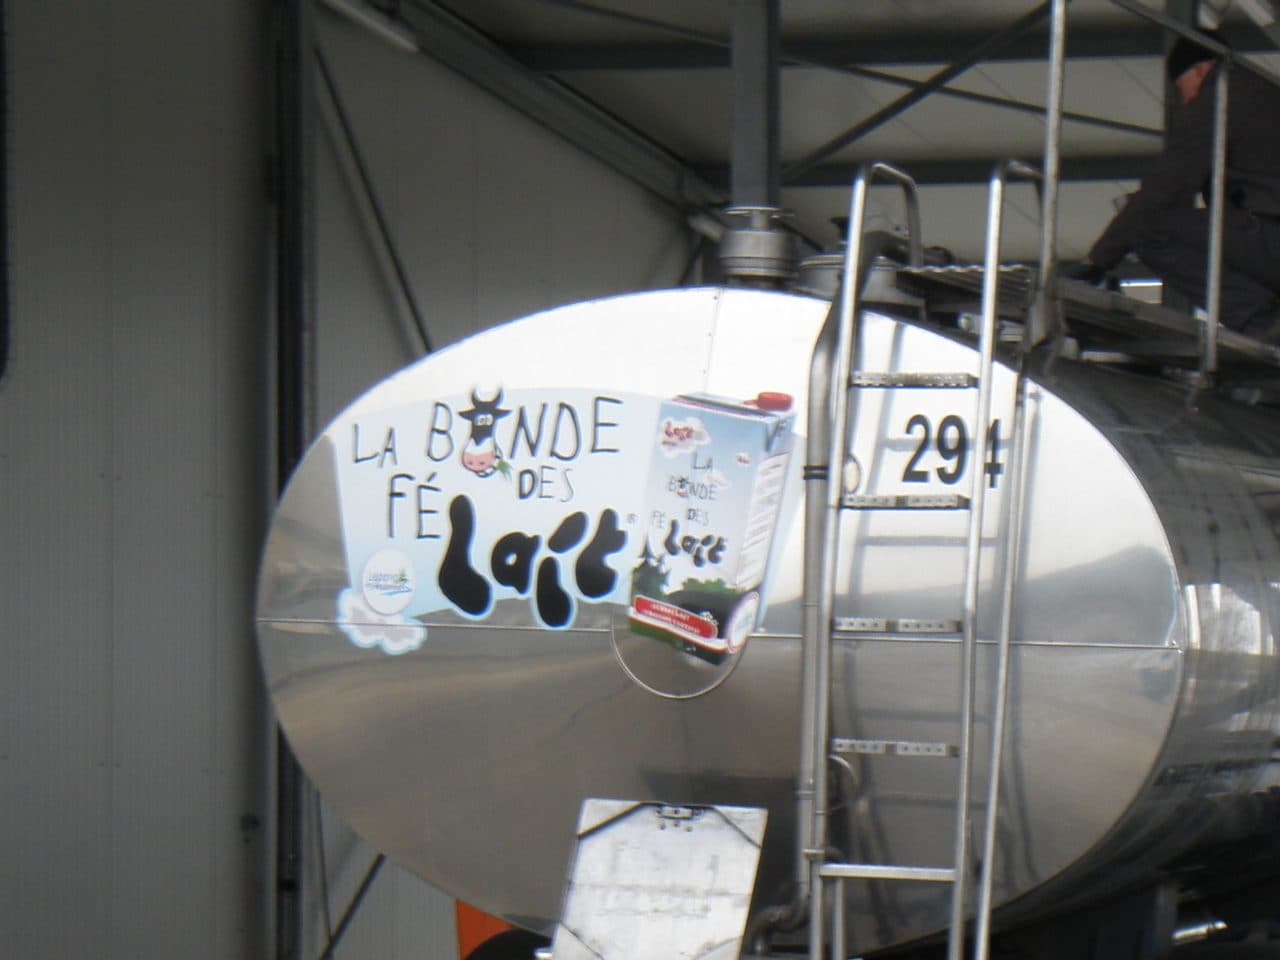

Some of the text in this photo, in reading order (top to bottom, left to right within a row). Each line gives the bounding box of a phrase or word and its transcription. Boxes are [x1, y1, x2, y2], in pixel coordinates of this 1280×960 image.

[353, 422, 398, 468] LA
[902, 414, 1004, 489] 294
[518, 464, 575, 503] DES
[388, 471, 442, 540] FÉ
[438, 494, 628, 629] Lait
